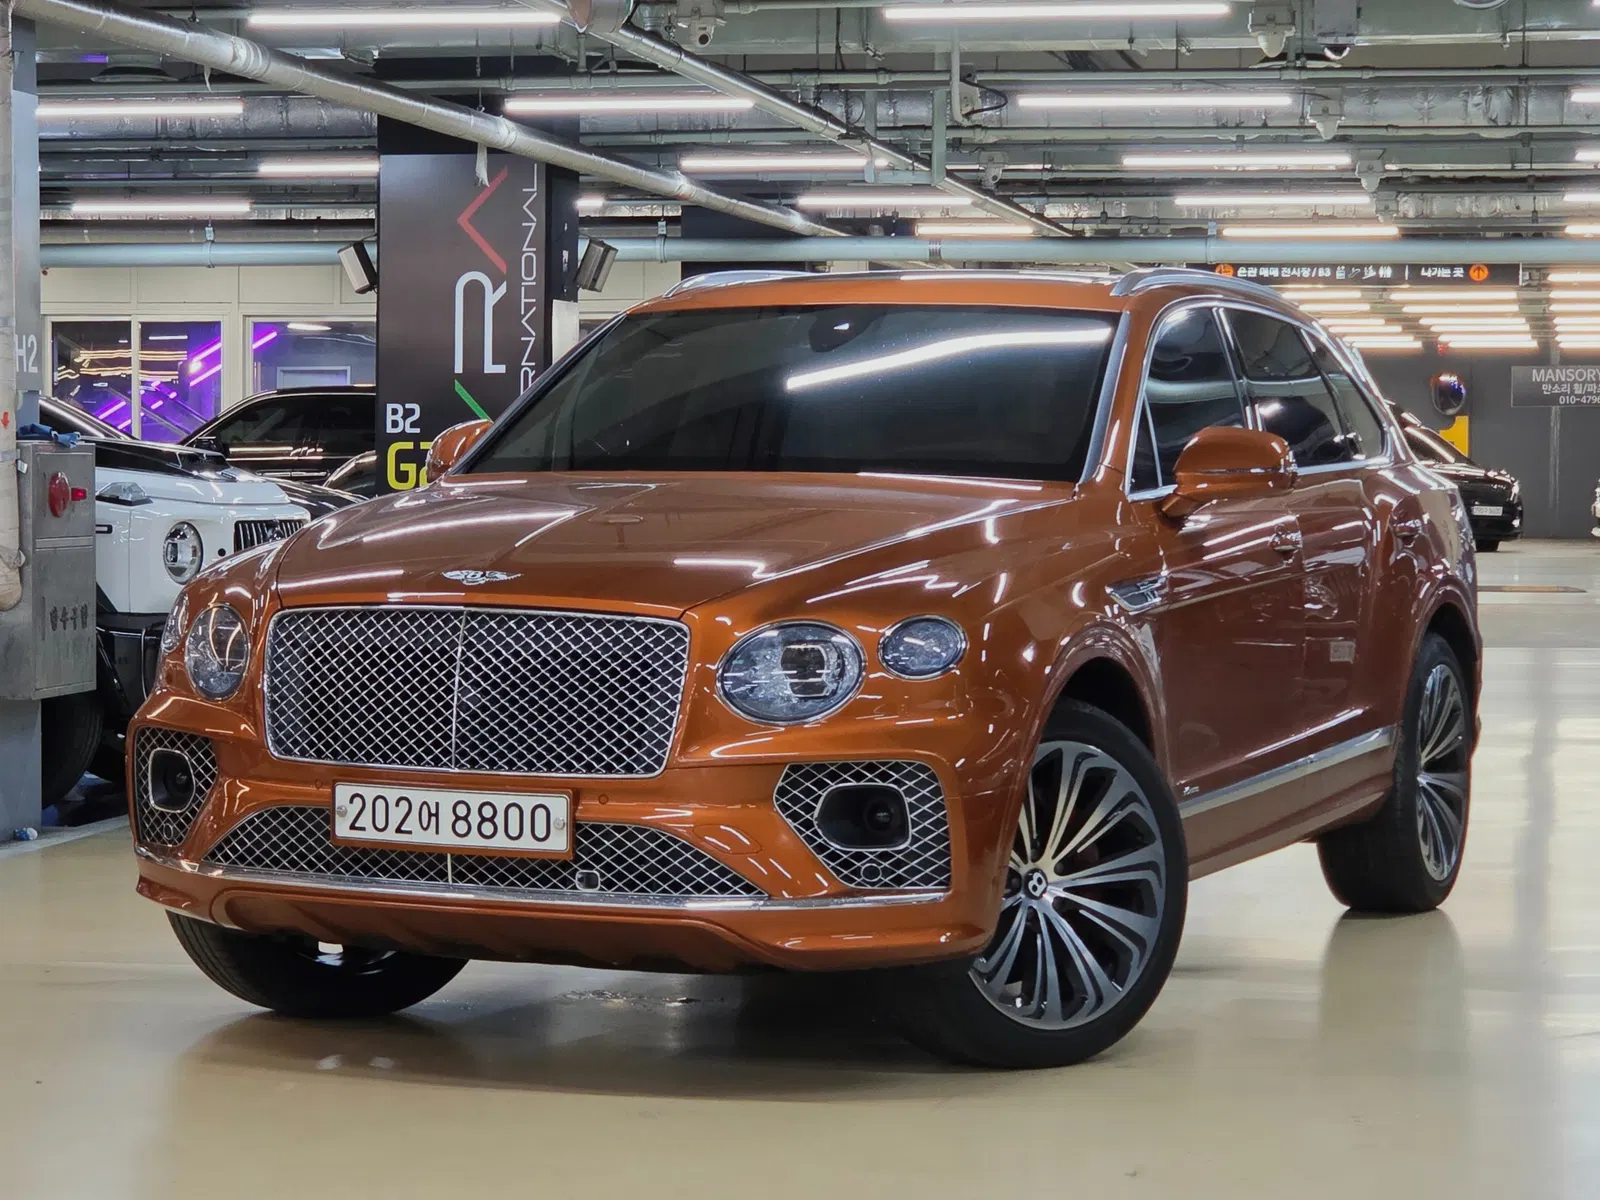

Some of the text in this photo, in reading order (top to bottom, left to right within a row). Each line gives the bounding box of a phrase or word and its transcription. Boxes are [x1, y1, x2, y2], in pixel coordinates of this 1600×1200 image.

[1420, 267, 1451, 278] 나가는
[15, 334, 38, 373] H2
[1542, 383, 1570, 394] 만소리
[386, 403, 420, 433] B2
[348, 792, 552, 842] 202어 8800
